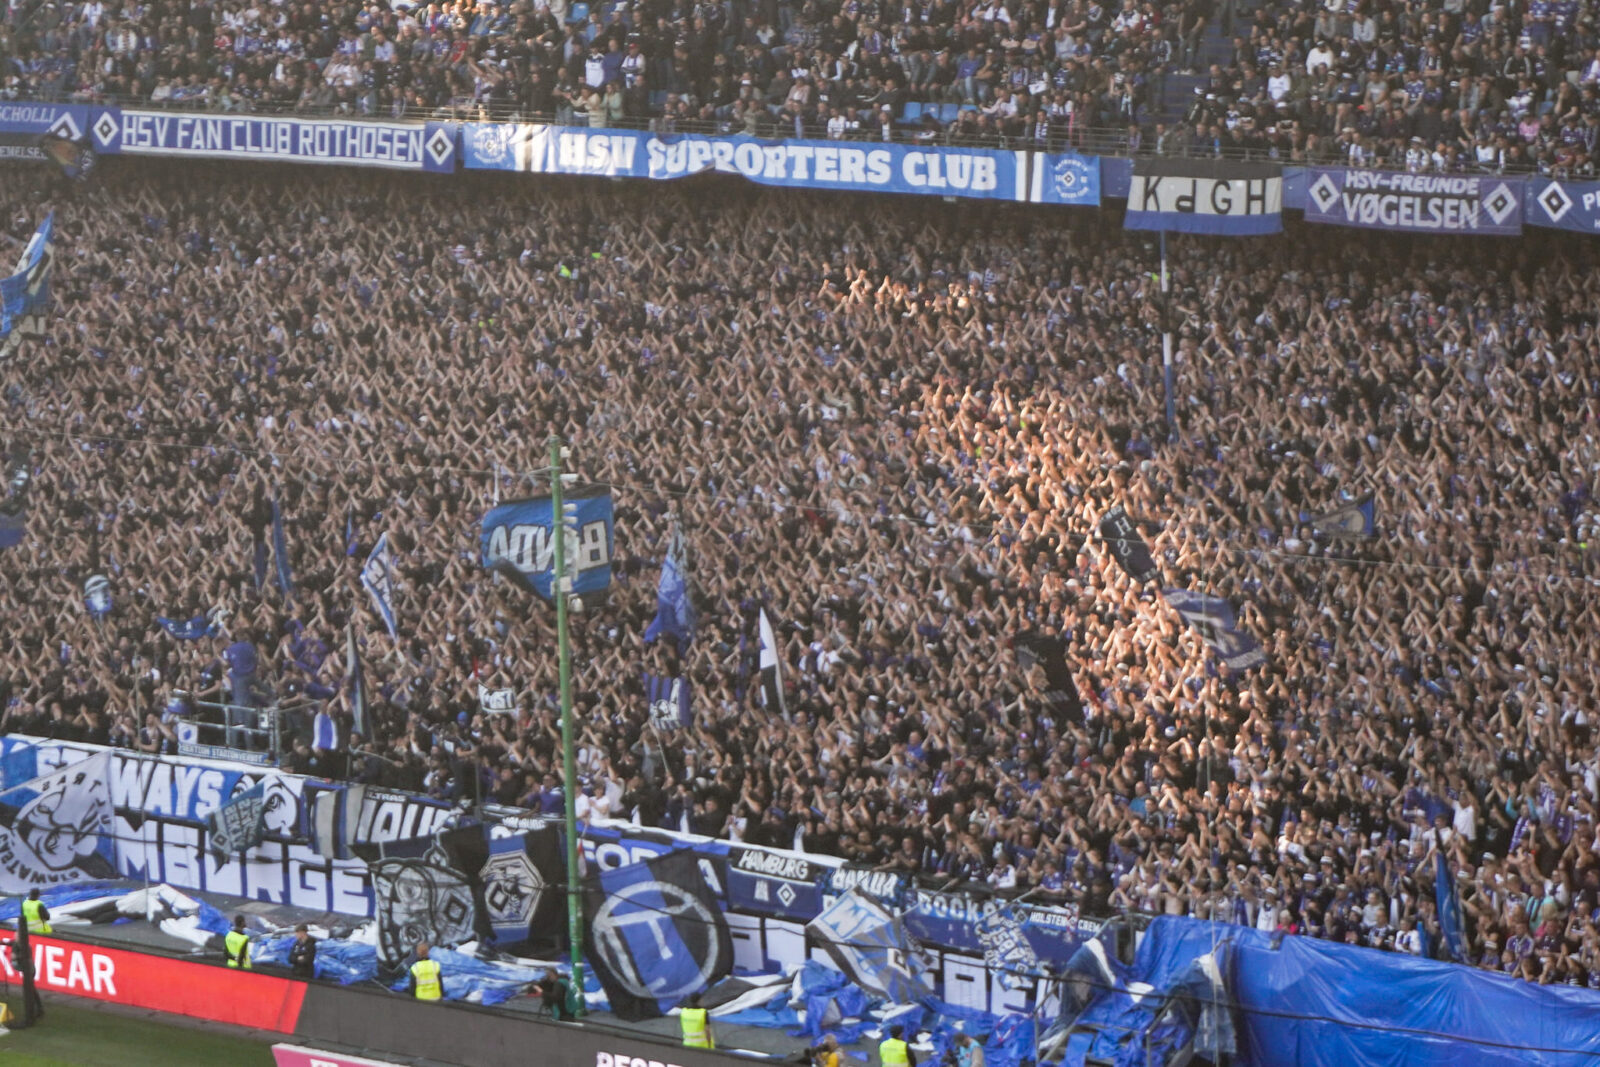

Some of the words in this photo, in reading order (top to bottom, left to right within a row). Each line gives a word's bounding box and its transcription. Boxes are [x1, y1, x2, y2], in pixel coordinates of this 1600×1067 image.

[121, 115, 168, 146] HSV
[176, 117, 224, 150] FAN
[229, 121, 291, 154] CLUB
[301, 126, 424, 163] ROTHOSEN
[559, 133, 637, 169] HSV
[646, 137, 892, 185] SUPPORTERS
[902, 152, 997, 191] CLUB
[1345, 171, 1480, 195] HSV-FREUNDE
[1342, 192, 1479, 228] VØGELSEN
[738, 849, 809, 880] HAMBURG
[1029, 911, 1068, 927] HOLSTEN
